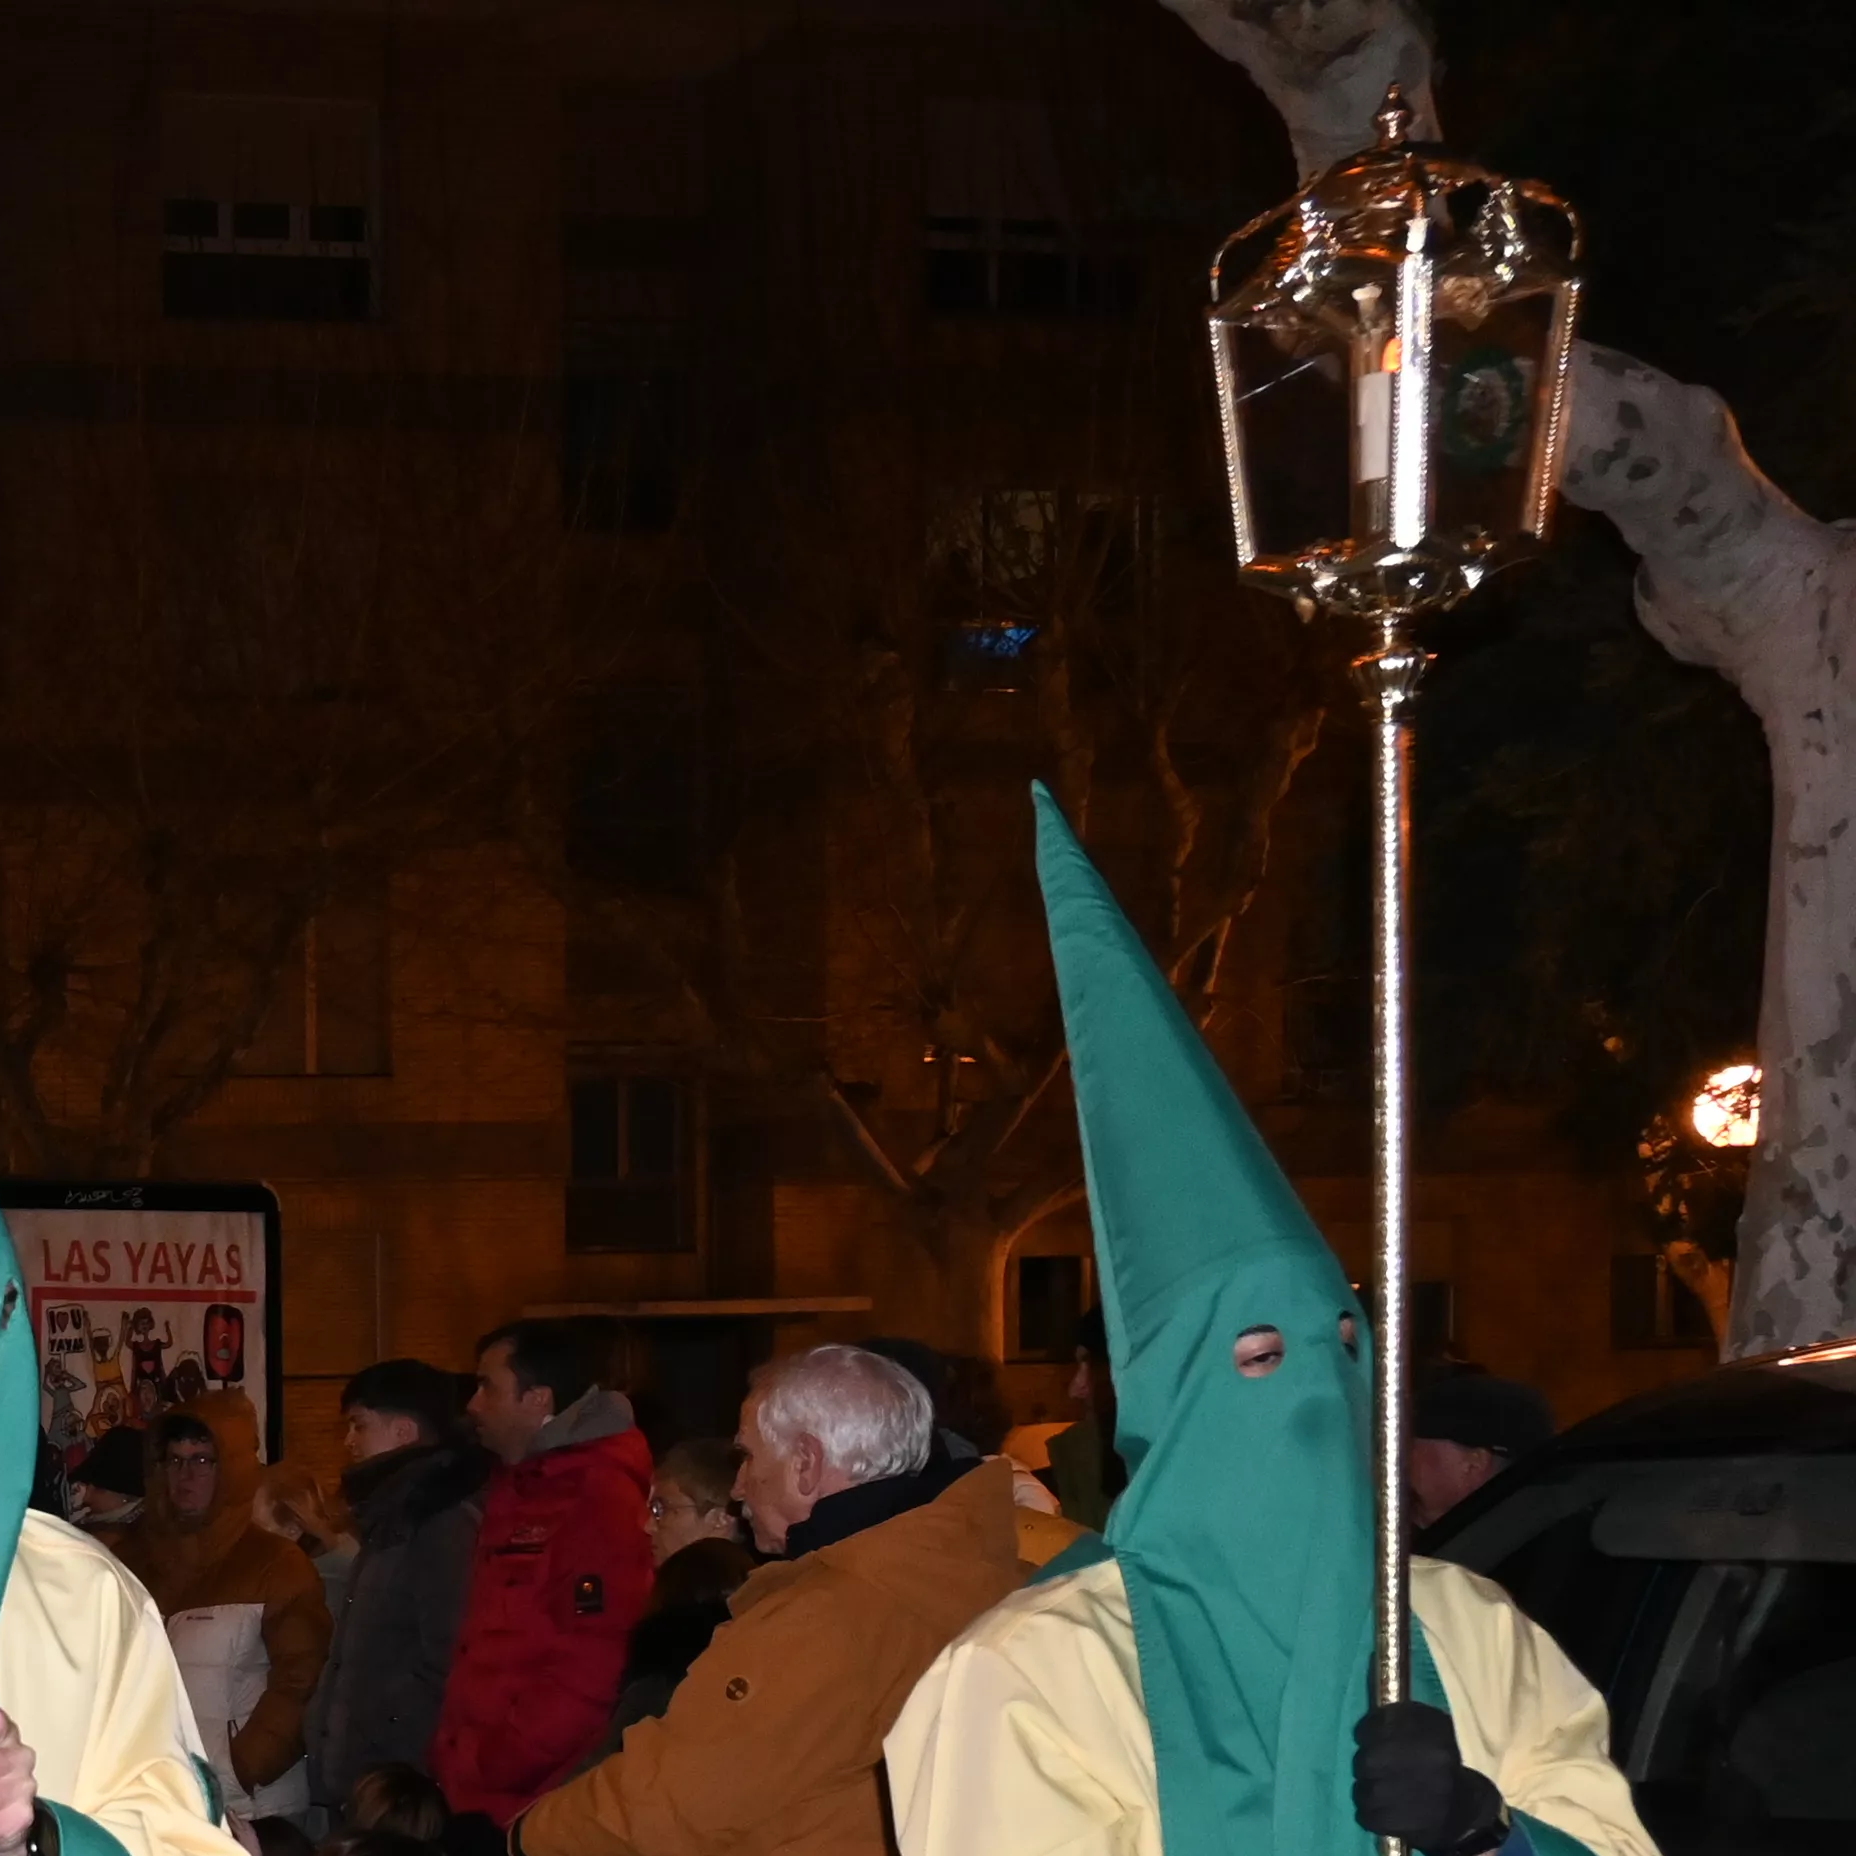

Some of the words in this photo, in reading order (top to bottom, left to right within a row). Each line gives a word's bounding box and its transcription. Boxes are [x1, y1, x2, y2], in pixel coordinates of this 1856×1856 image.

[42, 1238, 111, 1283] LAS
[123, 1241, 242, 1285] YAYAS
[49, 1310, 56, 1333] I
[70, 1309, 82, 1330] U
